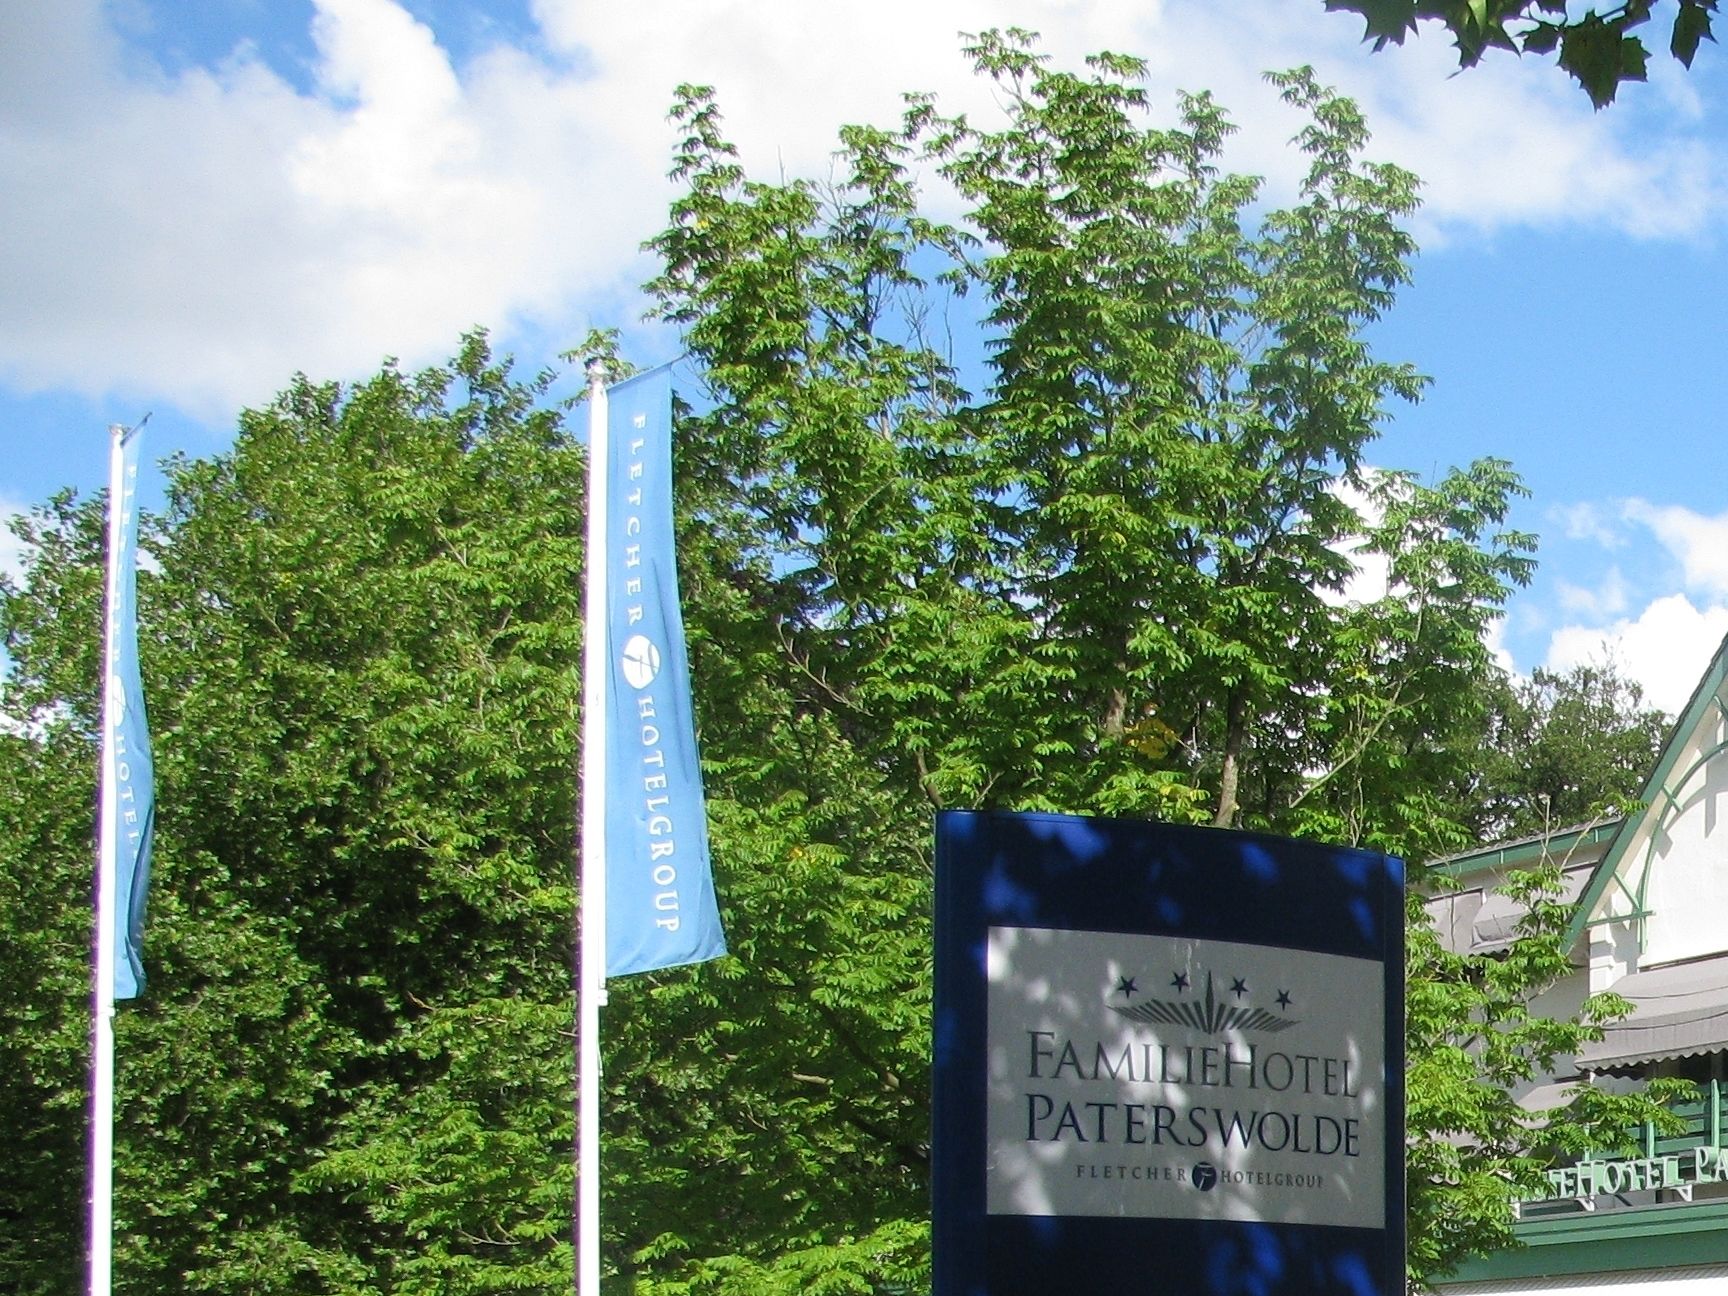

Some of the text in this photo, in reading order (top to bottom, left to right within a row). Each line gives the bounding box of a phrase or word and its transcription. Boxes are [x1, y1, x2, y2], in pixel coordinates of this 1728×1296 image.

[625, 412, 681, 933] FLETCHER HOTELGROUP
[1026, 1030, 1358, 1099] FAMILIEHOTEL
[1024, 1093, 1361, 1158] PATERSWOLDE
[1075, 1164, 1323, 1189] FLETCHER HOTELGROUP
